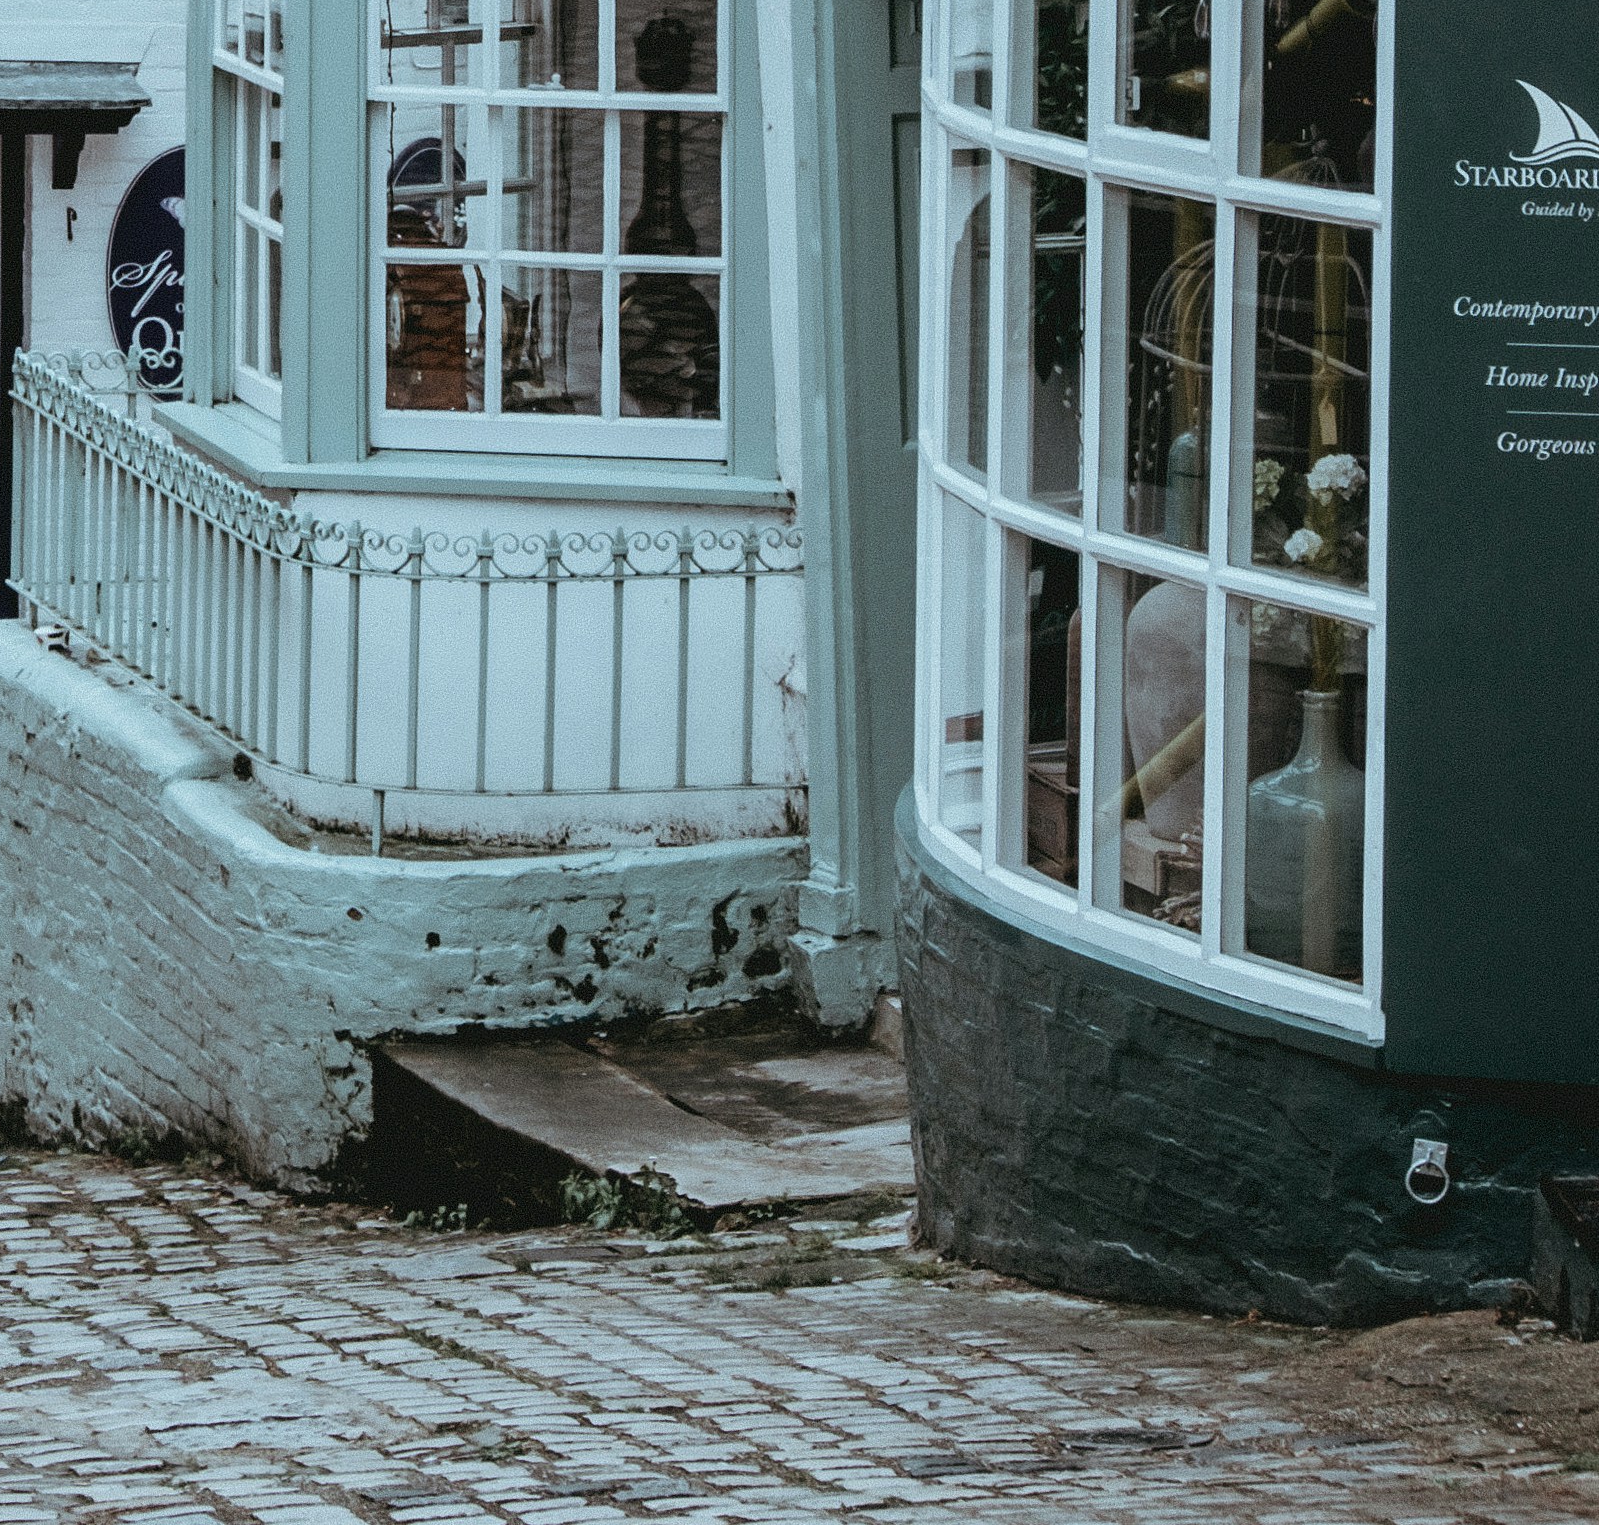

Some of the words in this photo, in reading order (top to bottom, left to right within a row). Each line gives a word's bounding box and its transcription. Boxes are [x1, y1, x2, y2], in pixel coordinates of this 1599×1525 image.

[1521, 201, 1576, 217] Guided
[1578, 202, 1595, 223] by
[1453, 296, 1599, 327] Contemporary
[1485, 365, 1549, 387] Home
[1496, 431, 1597, 461] Gorgeous
